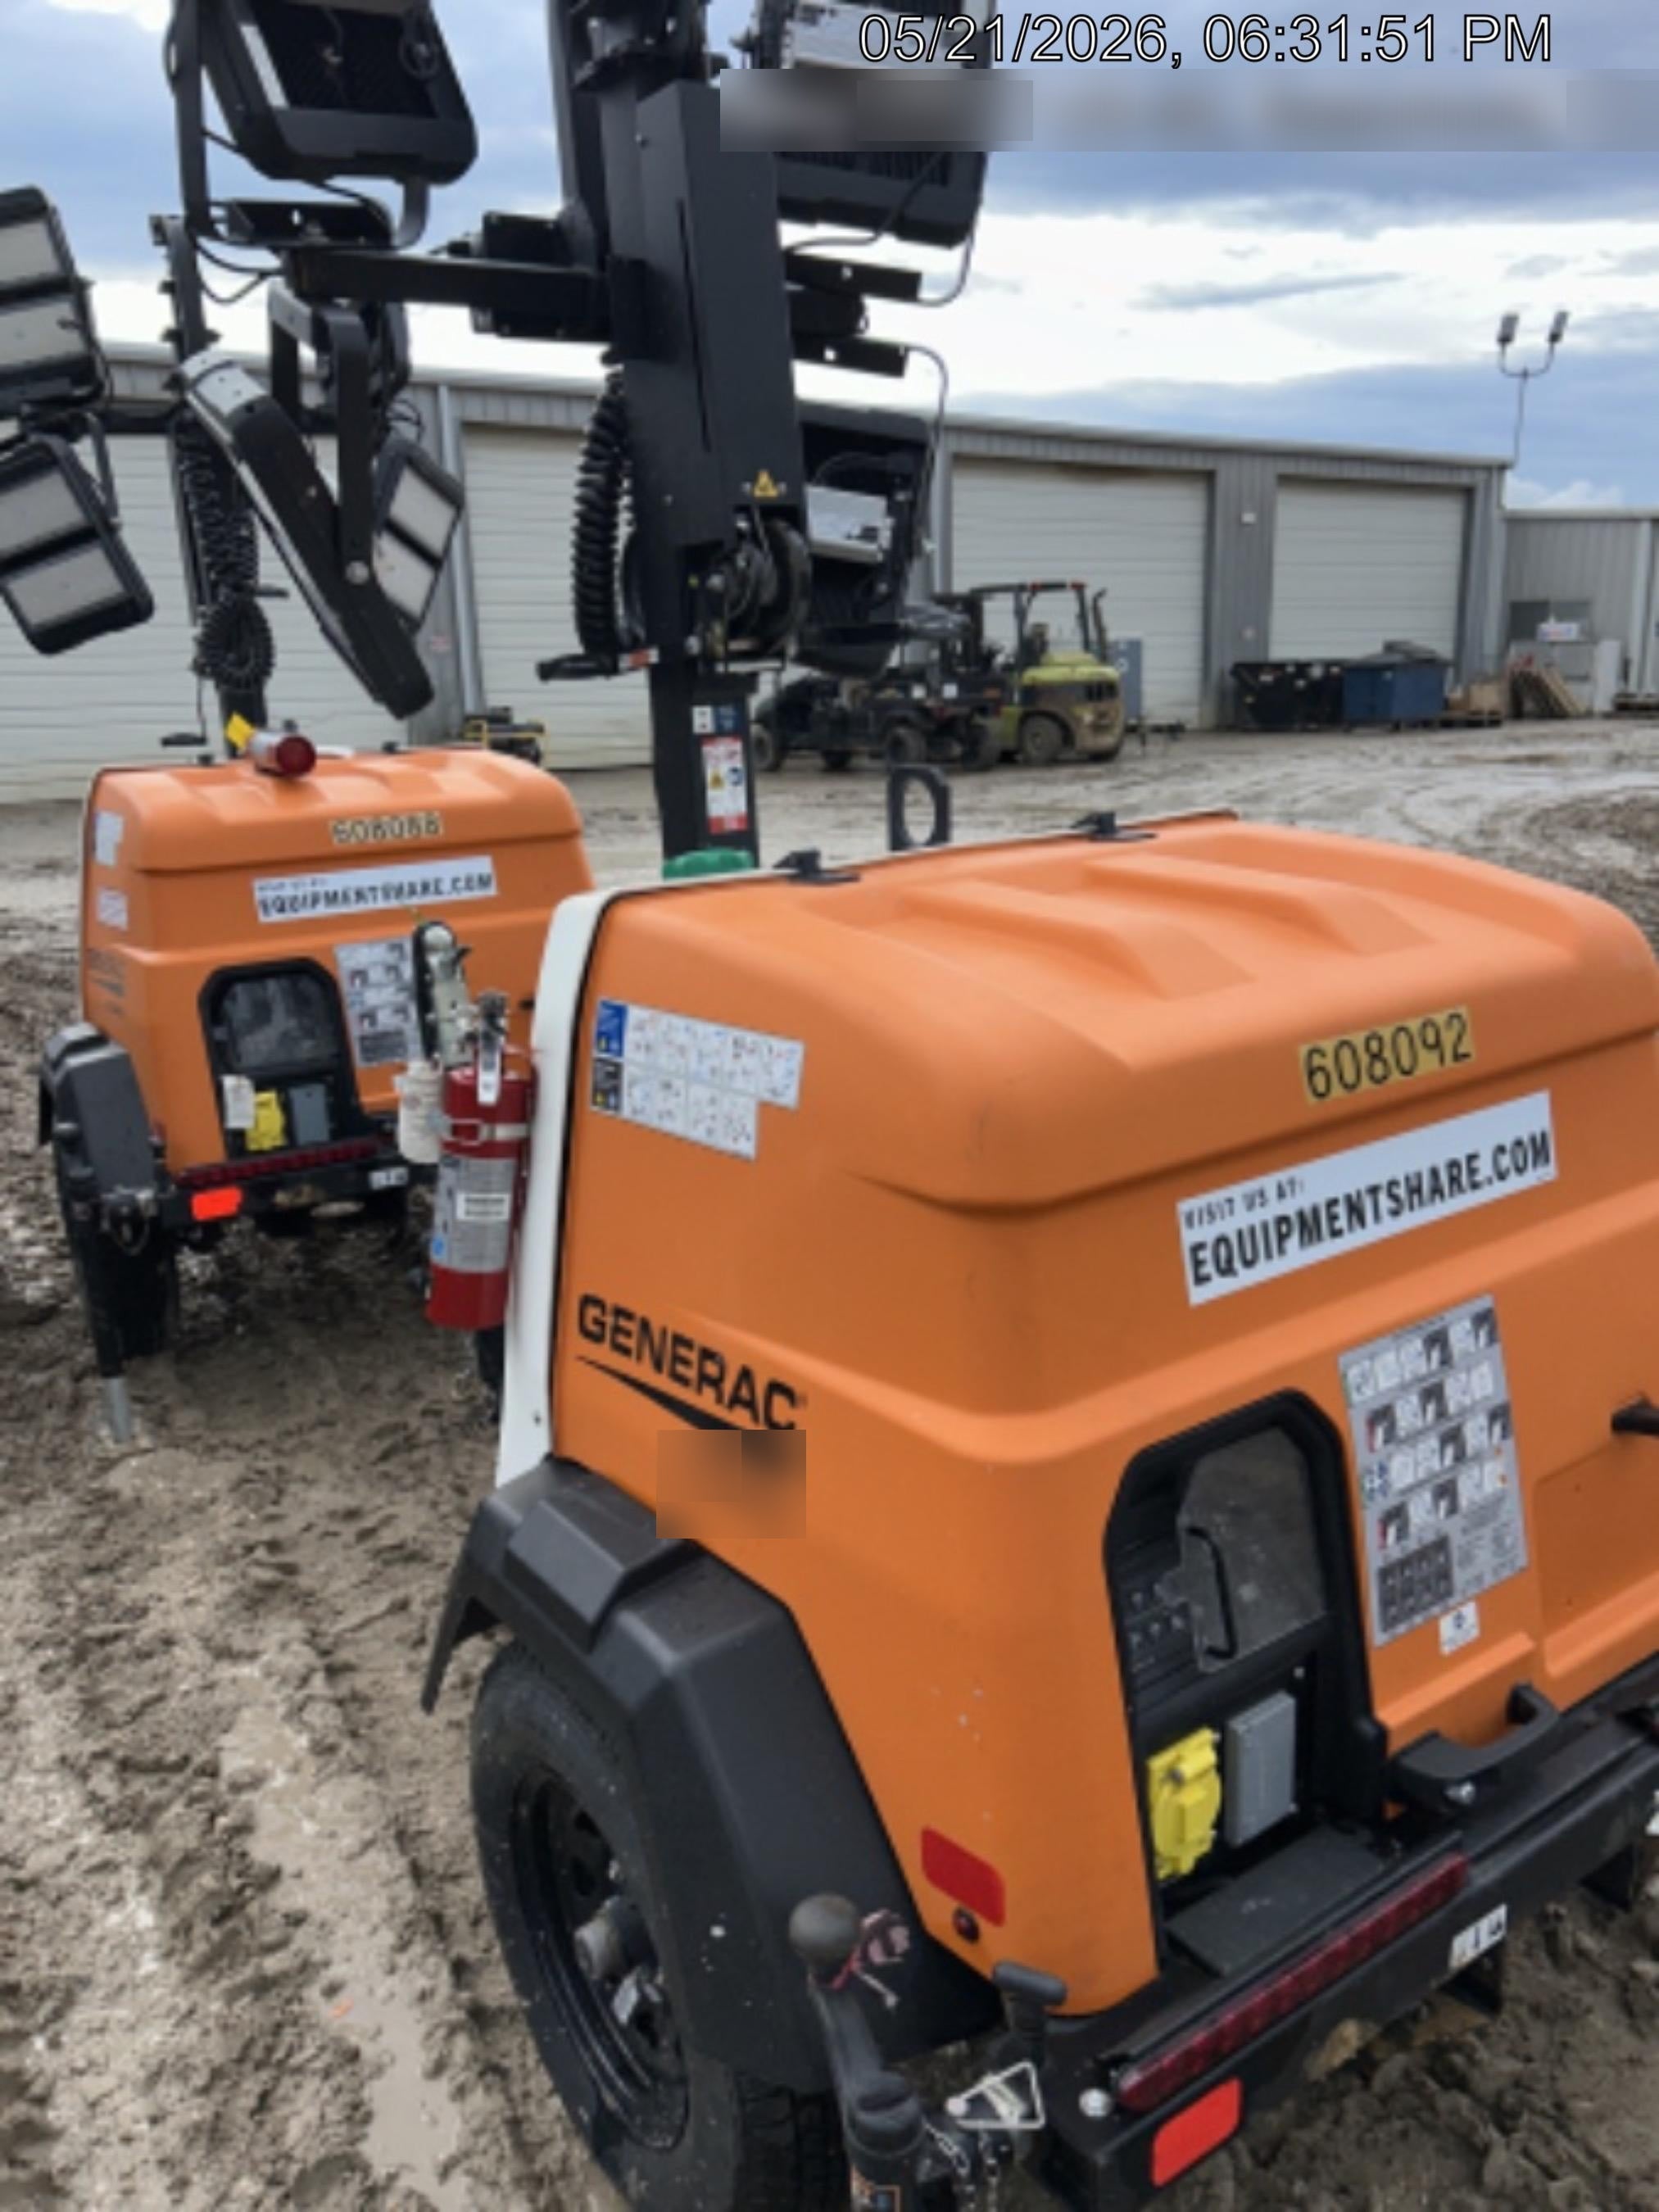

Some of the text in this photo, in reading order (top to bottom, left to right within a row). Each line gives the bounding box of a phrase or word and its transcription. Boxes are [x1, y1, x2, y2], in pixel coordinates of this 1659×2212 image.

[1305, 1012, 1471, 1101] 608092
[1185, 1196, 1235, 1230] VISIT
[1241, 1185, 1268, 1212] US
[1190, 1129, 1551, 1287] EQUIPMENTSHARE.COM
[578, 1292, 797, 1430] GENERAC
